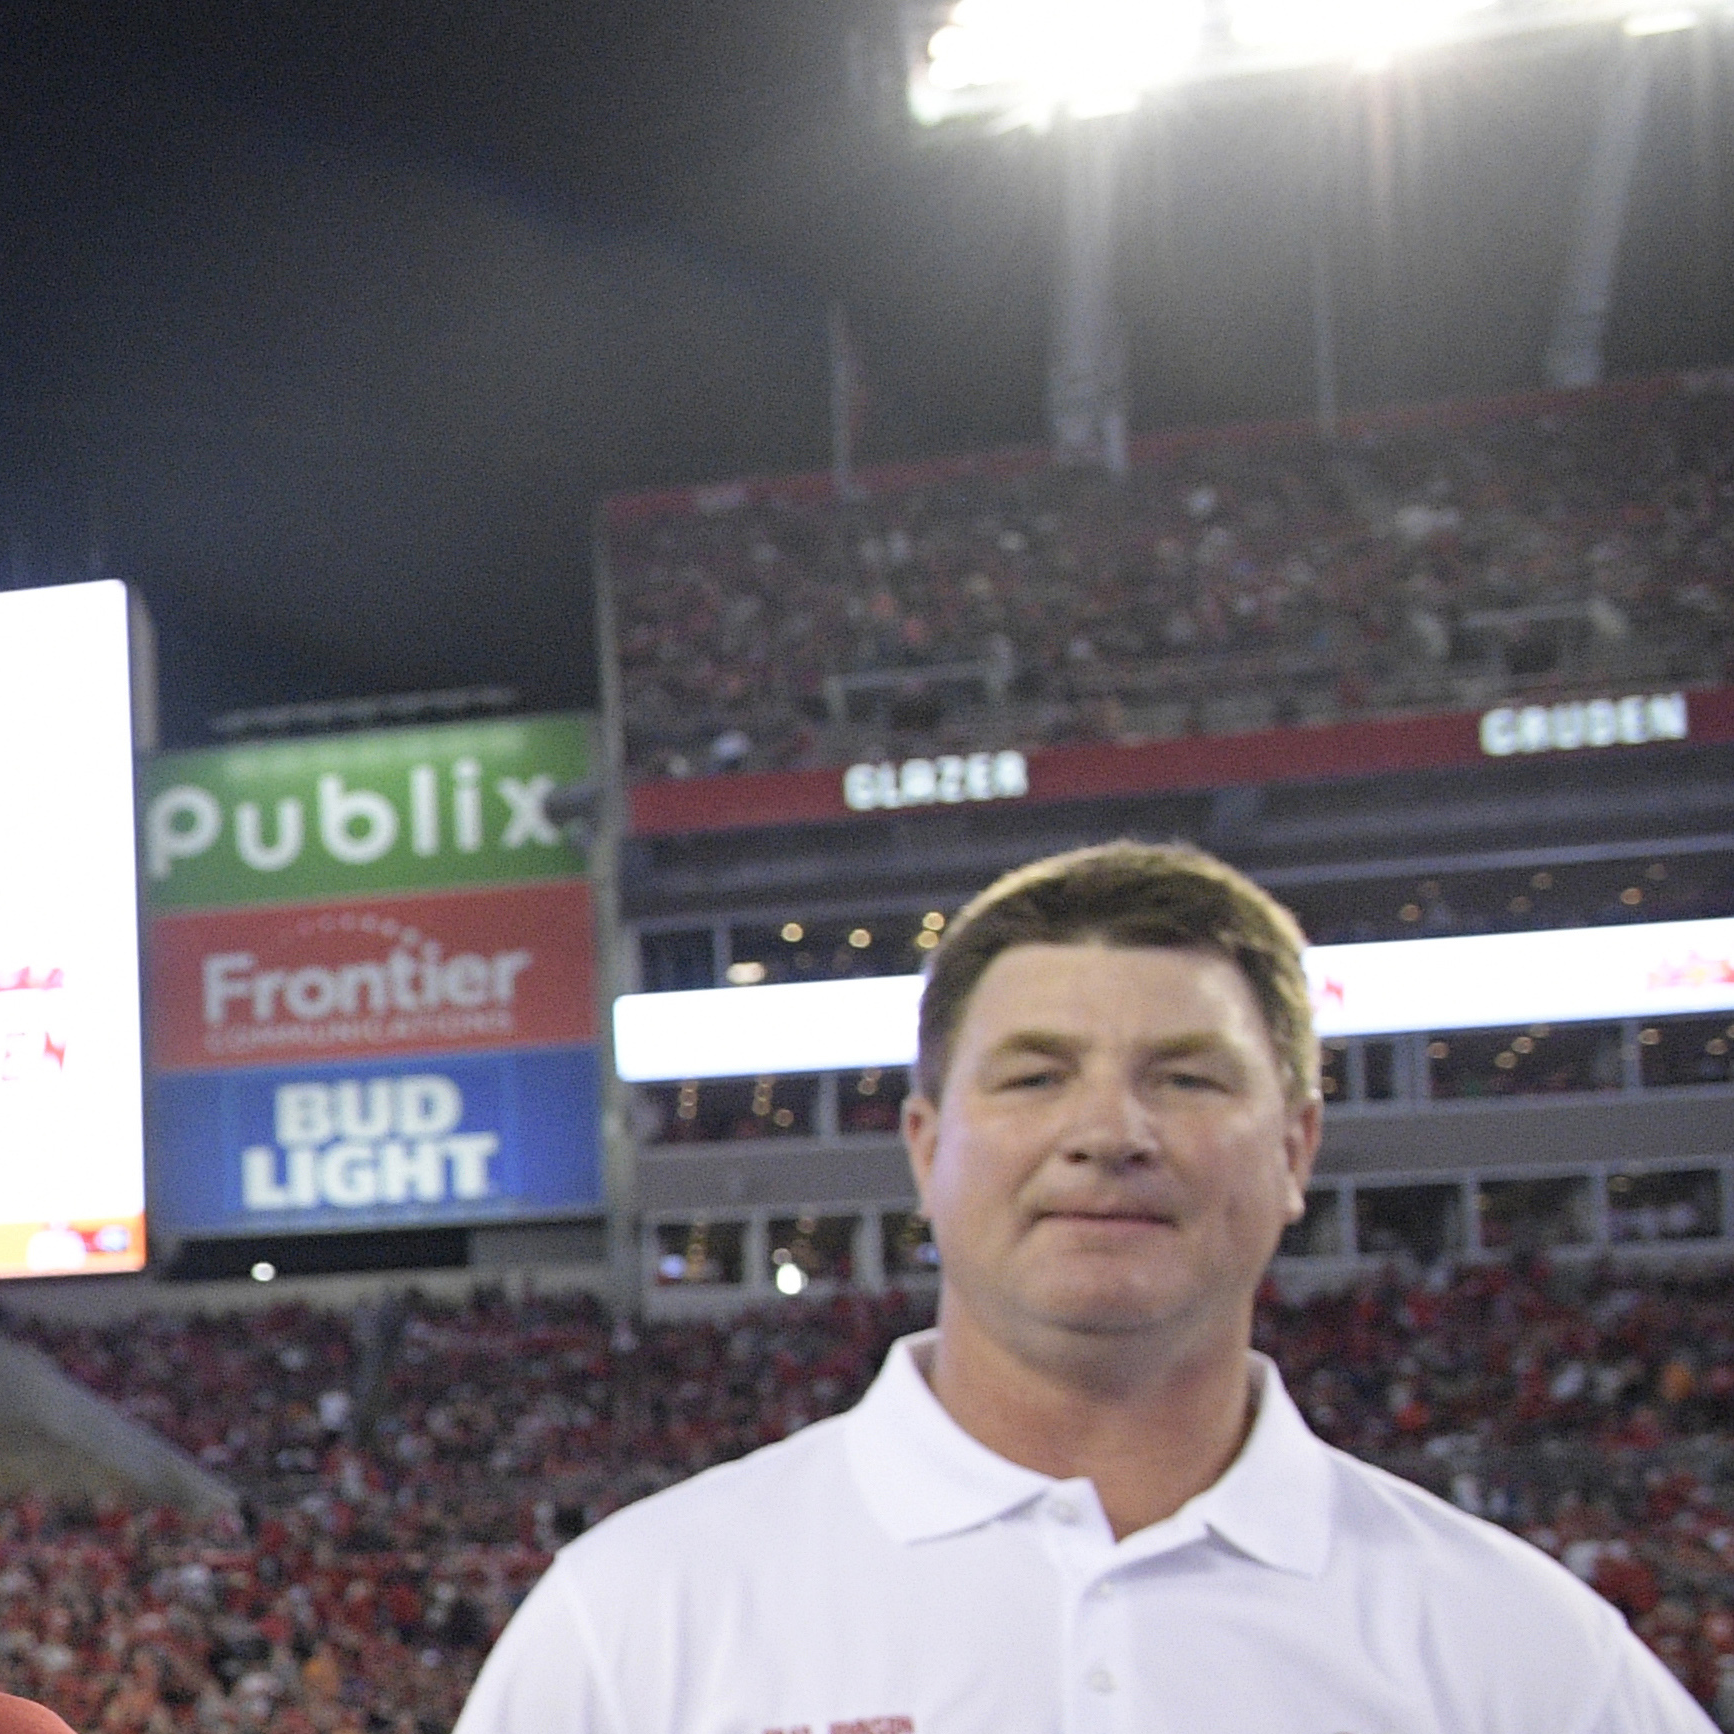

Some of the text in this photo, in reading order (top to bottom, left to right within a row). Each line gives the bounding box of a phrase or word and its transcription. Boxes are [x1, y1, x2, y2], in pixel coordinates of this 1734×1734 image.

[1479, 692, 1688, 756] GRUDEN
[844, 750, 1028, 810] GLAZER
[202, 940, 532, 1025] Frontier
[275, 1074, 463, 1146] BUD
[241, 1133, 498, 1211] LIGHT
